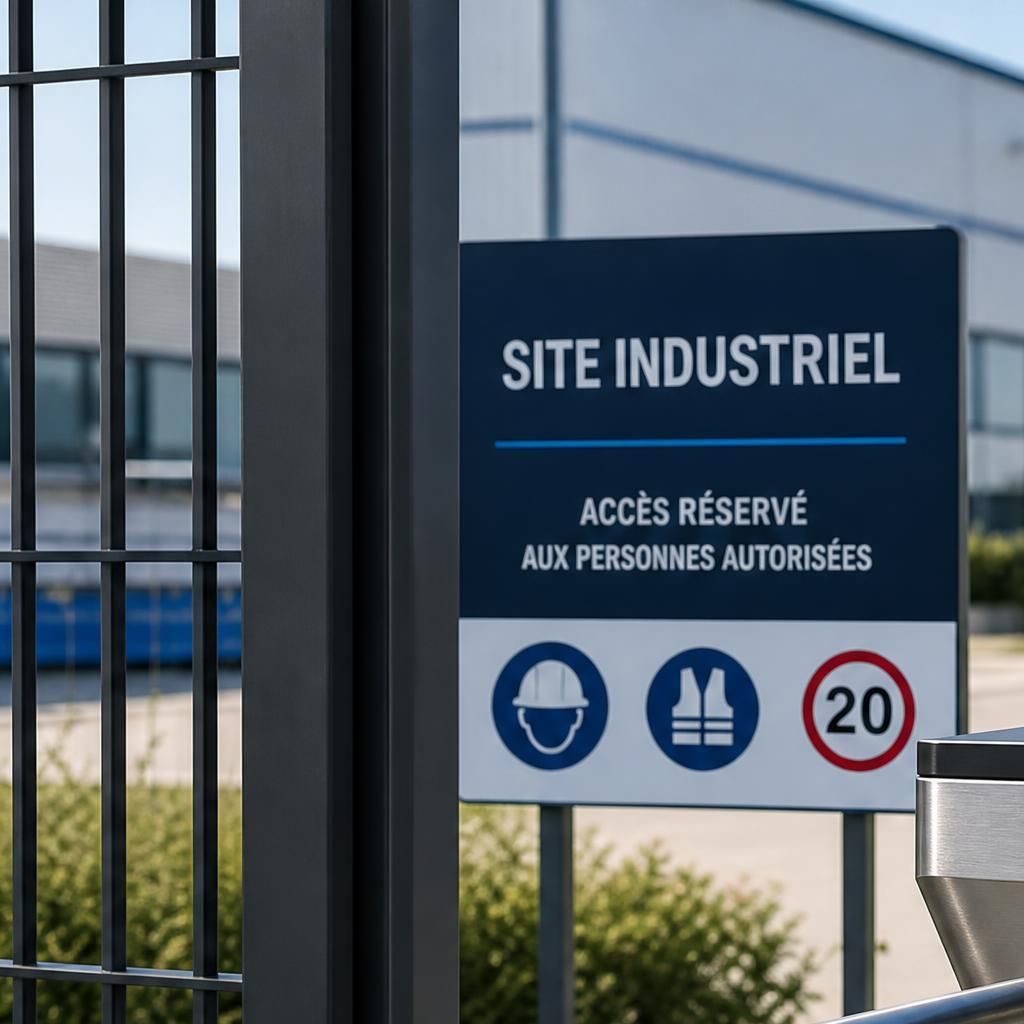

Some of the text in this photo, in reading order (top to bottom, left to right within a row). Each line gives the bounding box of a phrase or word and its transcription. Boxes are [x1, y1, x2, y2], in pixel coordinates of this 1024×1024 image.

[502, 332, 901, 391] SITE INDUSTRIEL
[579, 489, 808, 526] ACCÈS RÉSERVÉ
[521, 537, 873, 572] AUX PERSONNES AUTORISÉES
[825, 685, 893, 736] 20
